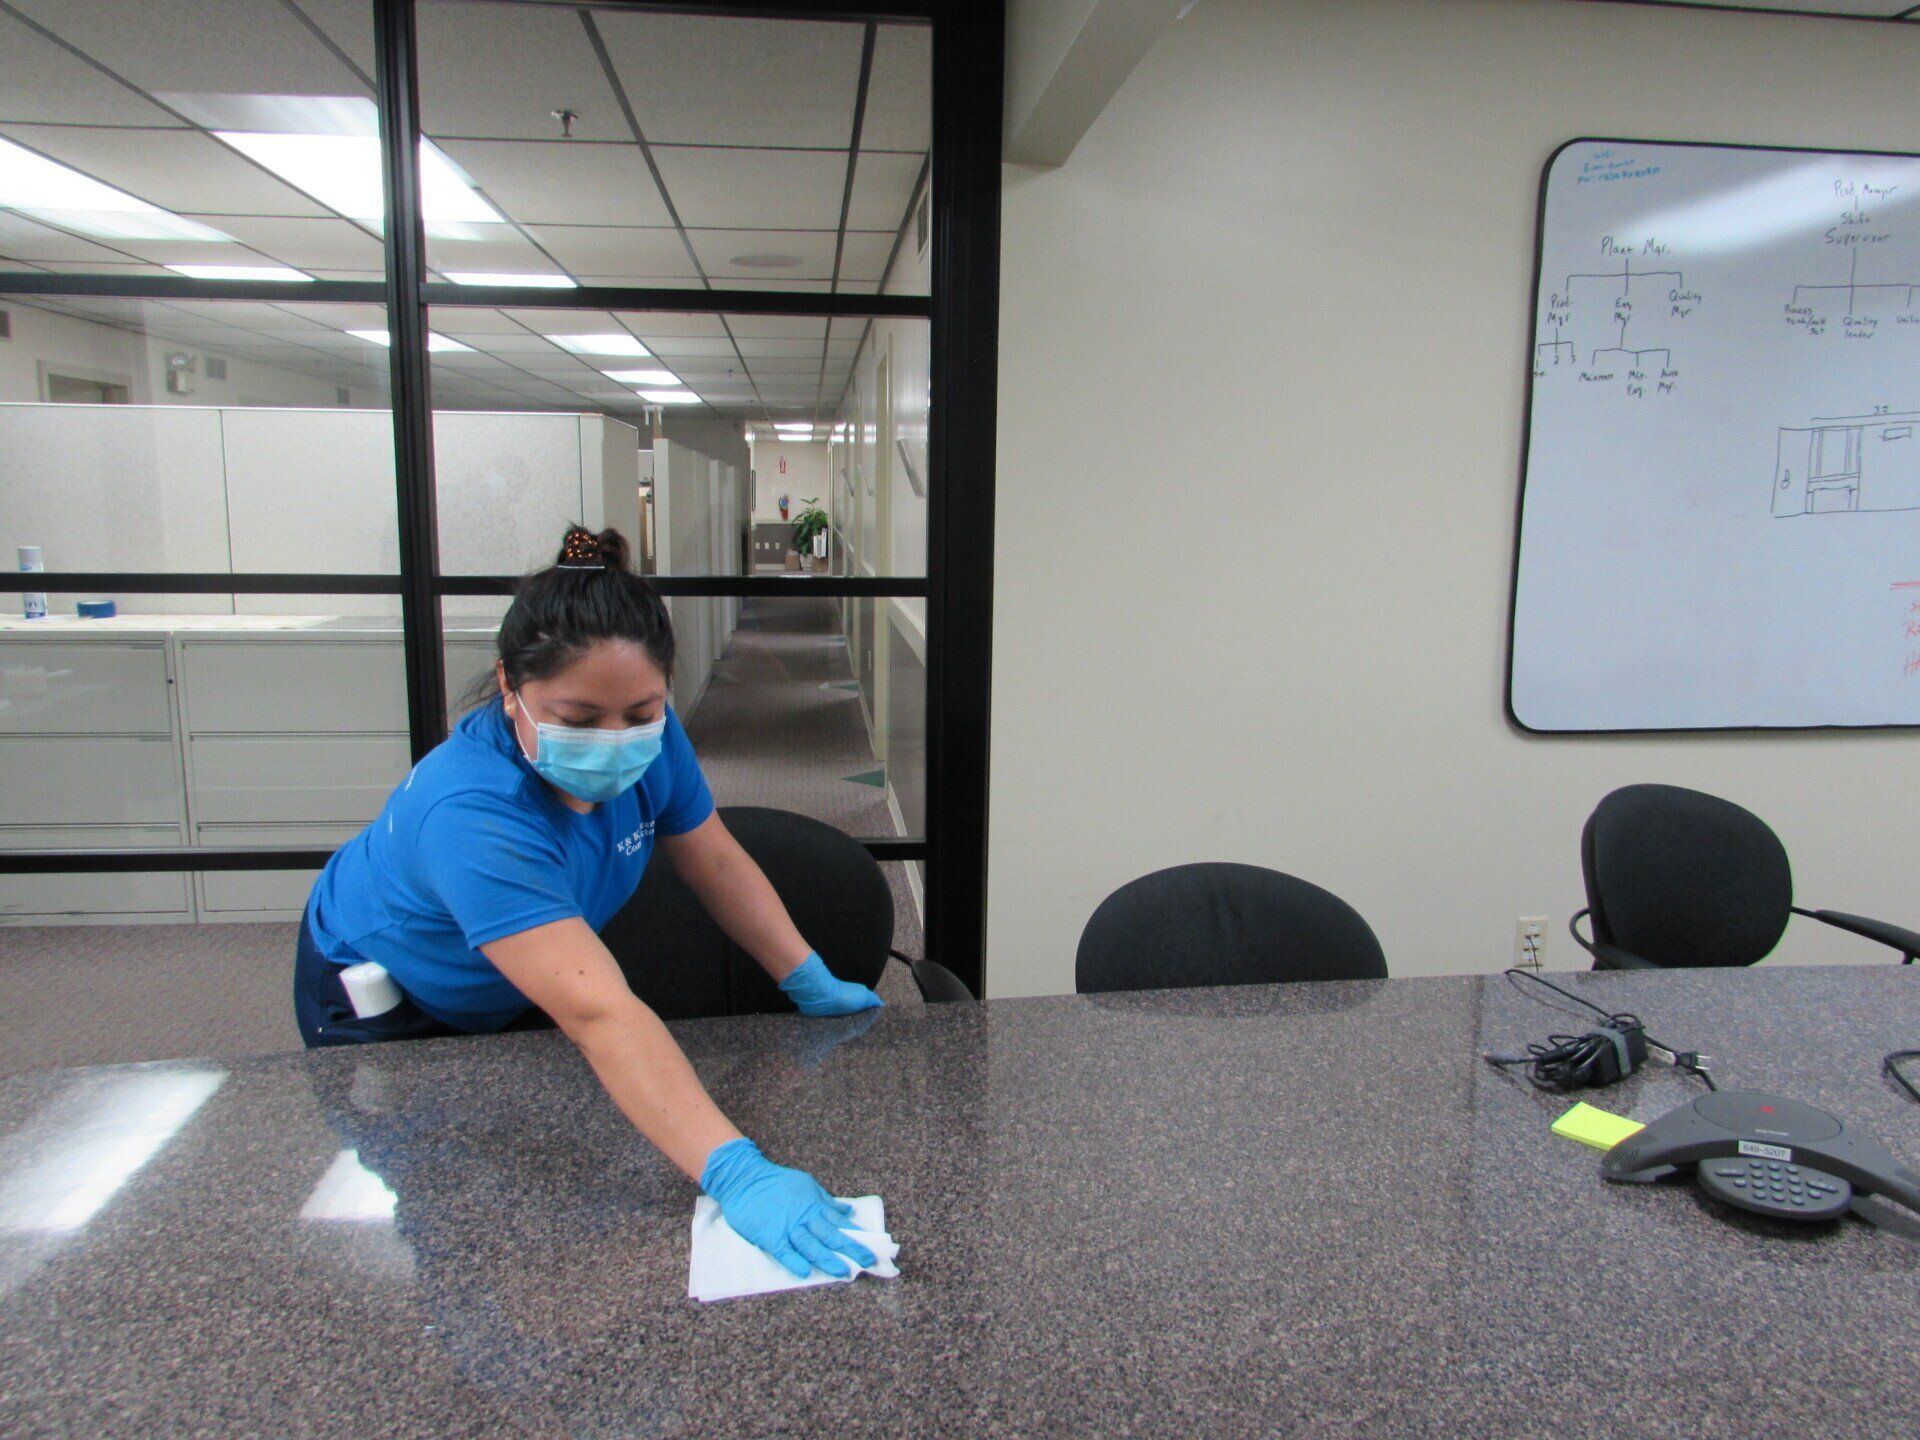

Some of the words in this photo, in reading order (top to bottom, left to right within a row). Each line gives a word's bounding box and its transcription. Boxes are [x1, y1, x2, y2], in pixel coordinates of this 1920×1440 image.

[1601, 236, 1633, 256] Plant
[1824, 227, 1890, 246] Supervisor
[1742, 1143, 1787, 1157] 649-5207
